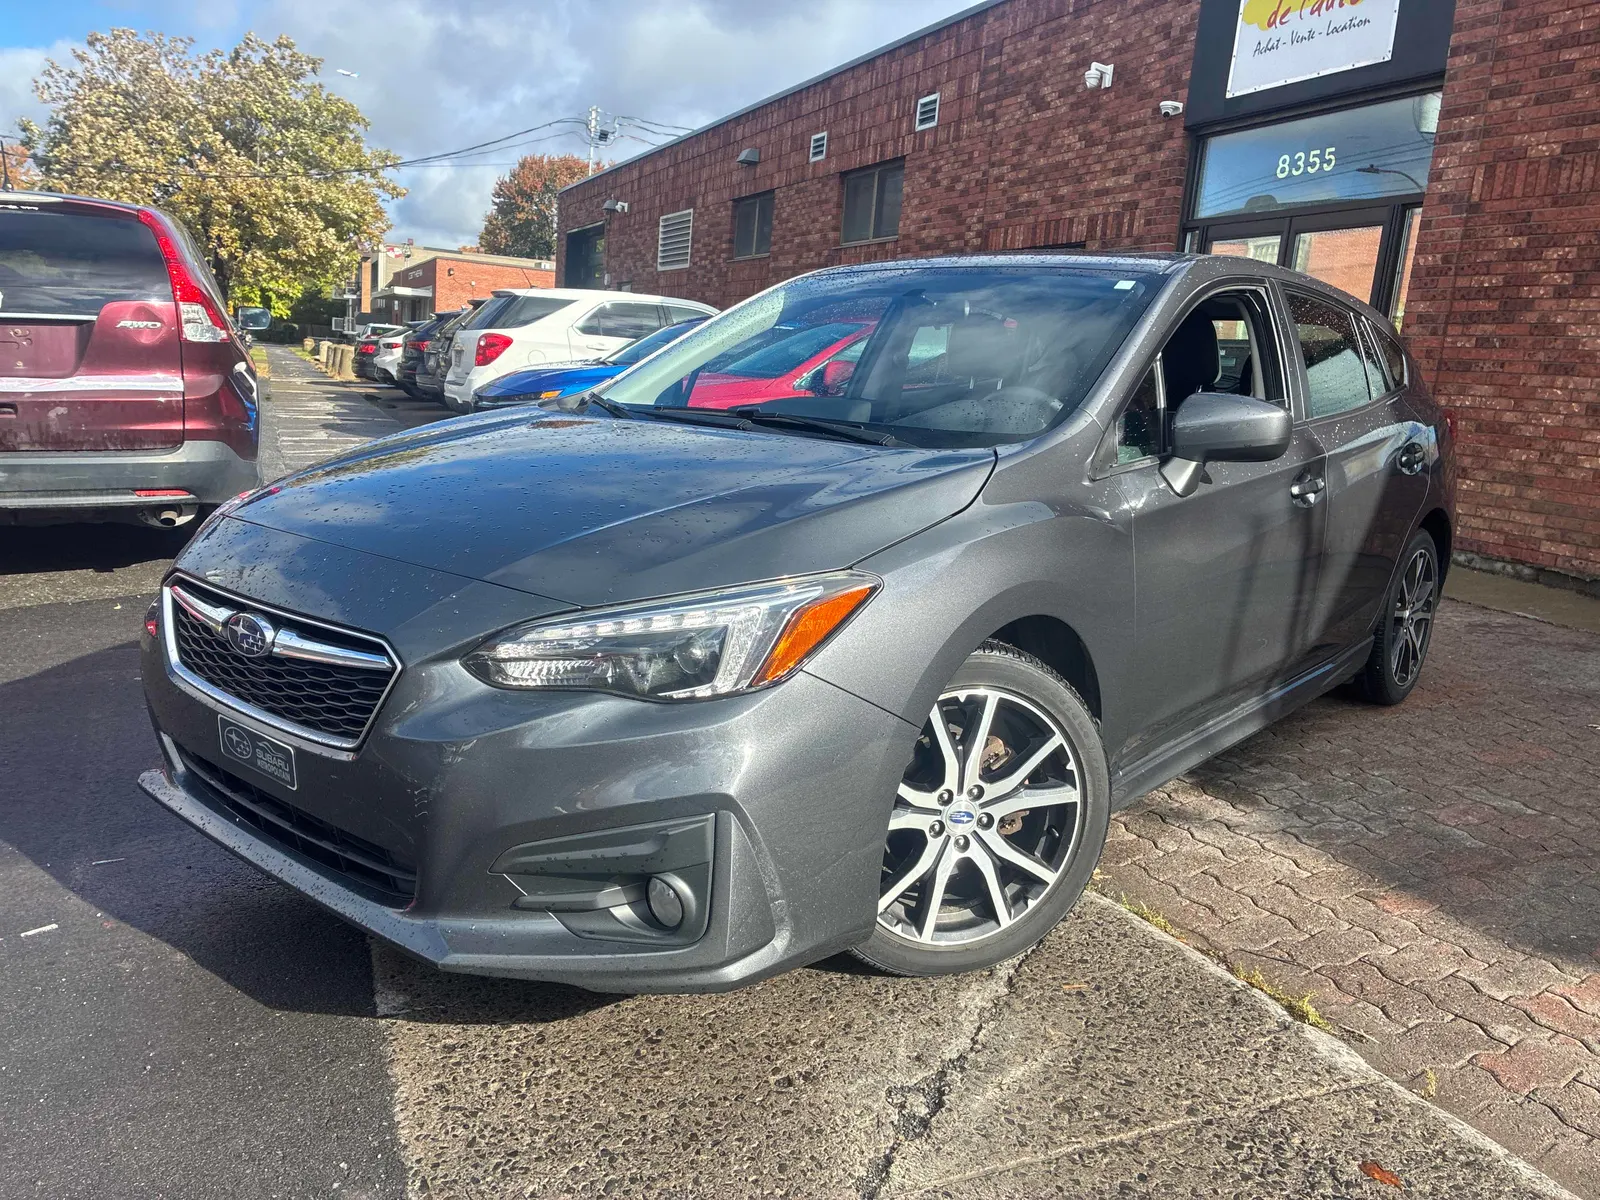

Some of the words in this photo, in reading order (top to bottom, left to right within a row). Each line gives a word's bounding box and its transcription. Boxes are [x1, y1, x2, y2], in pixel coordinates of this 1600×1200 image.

[1266, 0, 1292, 29] de
[1252, 36, 1281, 57] Achat
[1290, 28, 1316, 46] Vente
[1326, 16, 1371, 36] Location
[1276, 147, 1336, 179] 8355
[115, 320, 162, 329] AWD
[255, 748, 290, 772] SUBARU
